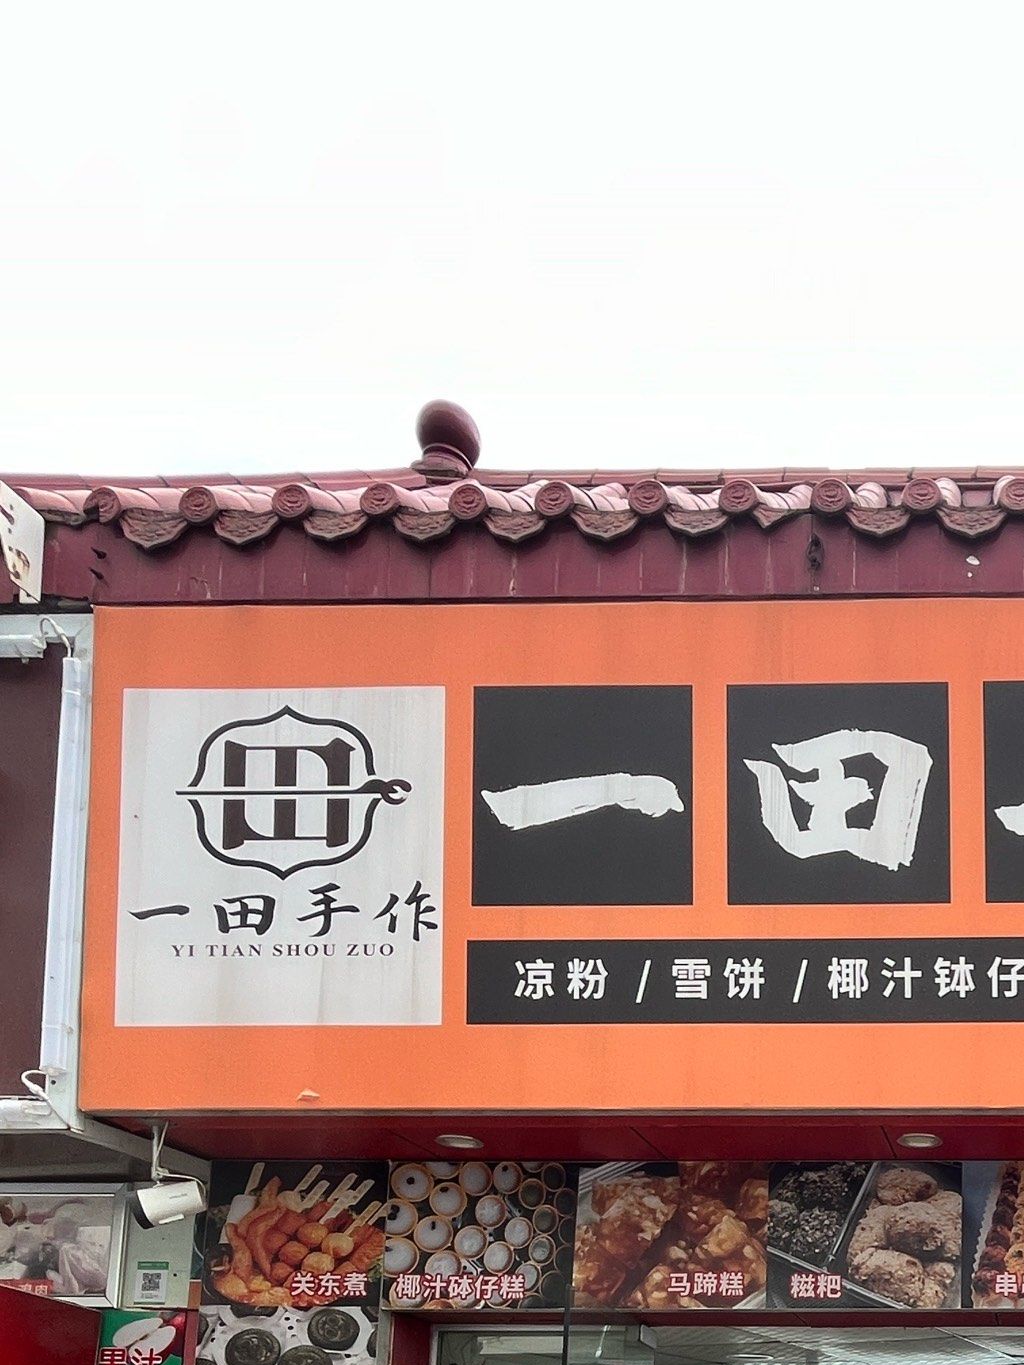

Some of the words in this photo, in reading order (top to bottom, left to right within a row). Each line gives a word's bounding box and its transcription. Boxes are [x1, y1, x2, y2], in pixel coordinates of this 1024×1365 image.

[127, 881, 438, 941] 一田手作
[171, 944, 195, 957] YI
[205, 944, 262, 957] TIAN
[272, 944, 336, 957] SHOU
[346, 944, 394, 957] ZUO
[514, 959, 608, 1000] 凉粉
[671, 959, 764, 1000] 雪饼
[291, 1272, 368, 1296] 关东煮
[396, 1274, 525, 1299] 椰汁砵仔糕
[667, 1272, 744, 1296] 马蹄糕
[790, 1274, 842, 1298] 糍粑
